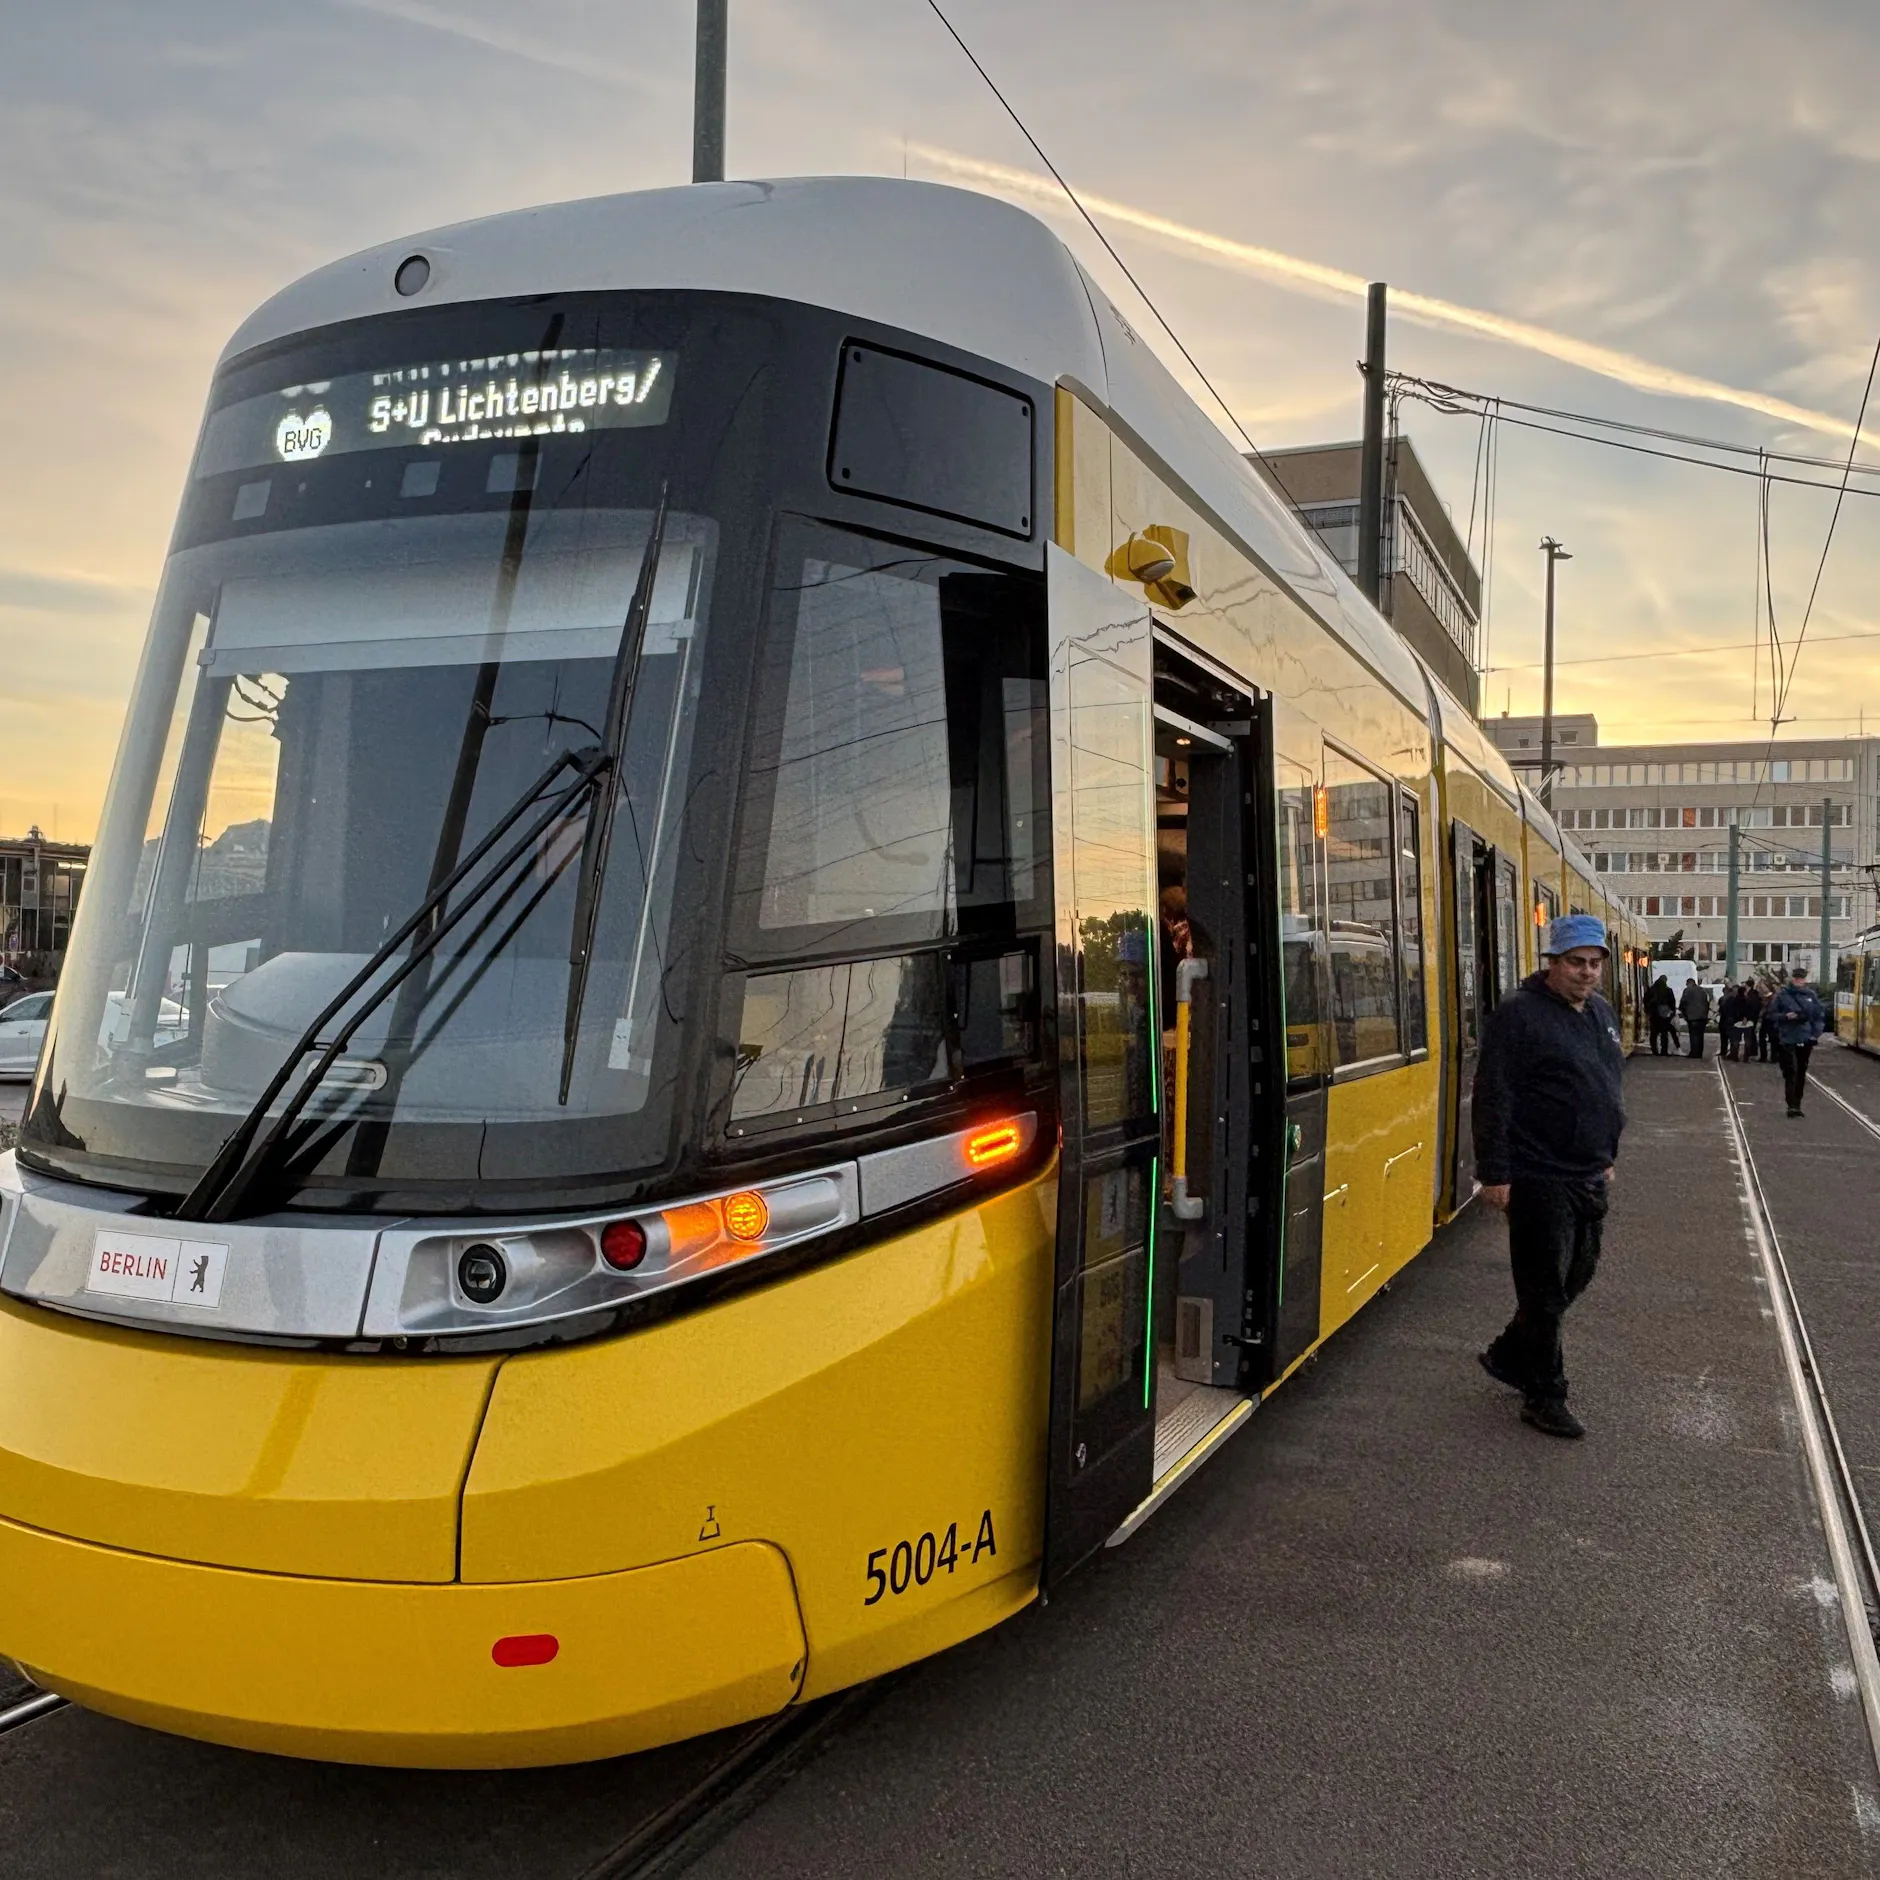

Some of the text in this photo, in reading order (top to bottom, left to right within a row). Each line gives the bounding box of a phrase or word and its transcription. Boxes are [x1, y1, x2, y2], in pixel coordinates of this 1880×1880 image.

[368, 394, 428, 433] S+U
[438, 357, 663, 424] Lichtenberg/
[284, 427, 322, 453] BVG
[100, 1251, 168, 1280] BERLIN
[864, 1509, 997, 1606] 5004-A
